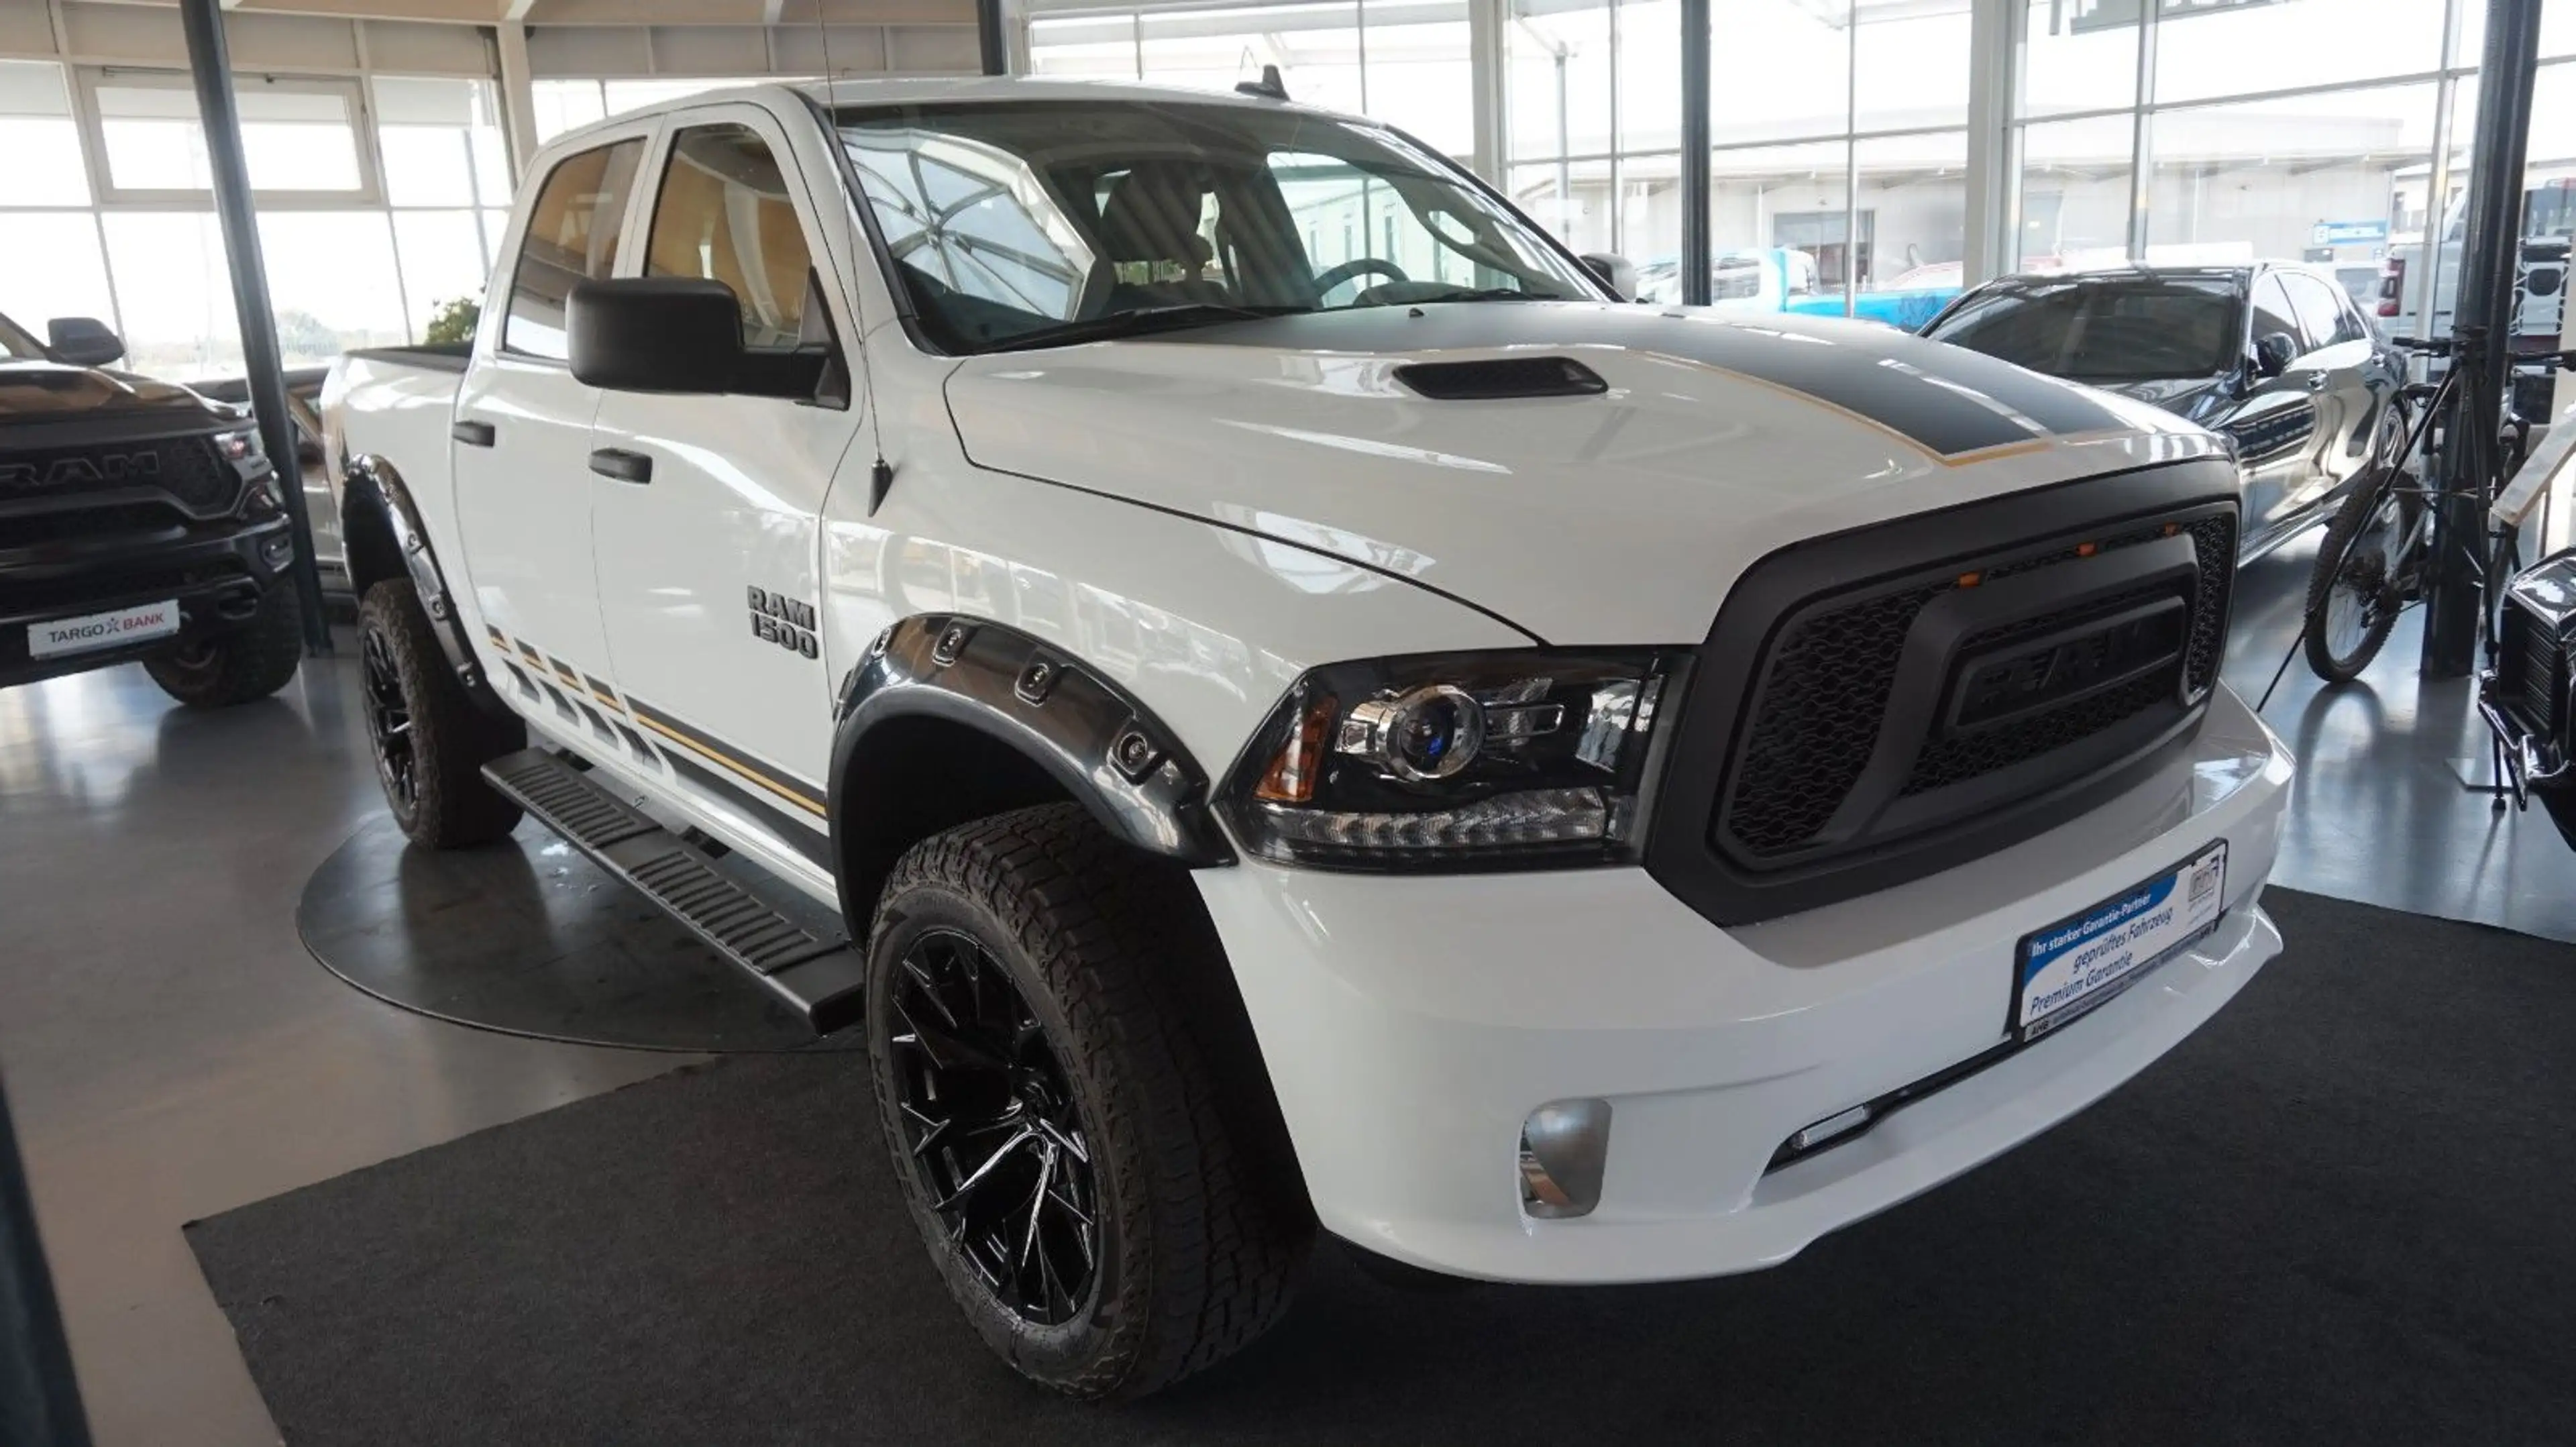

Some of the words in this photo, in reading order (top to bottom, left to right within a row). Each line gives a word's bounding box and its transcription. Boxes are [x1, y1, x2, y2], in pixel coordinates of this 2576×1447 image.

[48, 625, 104, 644] TARGO
[123, 612, 164, 631] BANK
[747, 585, 816, 631] RAM
[749, 611, 819, 659] 1500
[2032, 941, 2047, 957] Ihr
[2048, 928, 2082, 952] starker
[2082, 893, 2152, 936] Garantie-Partner
[2073, 932, 2127, 975] geprüftes
[2127, 906, 2174, 943] Fahrzeug
[2030, 978, 2084, 1018] Premium
[2086, 951, 2133, 988] Garantie
